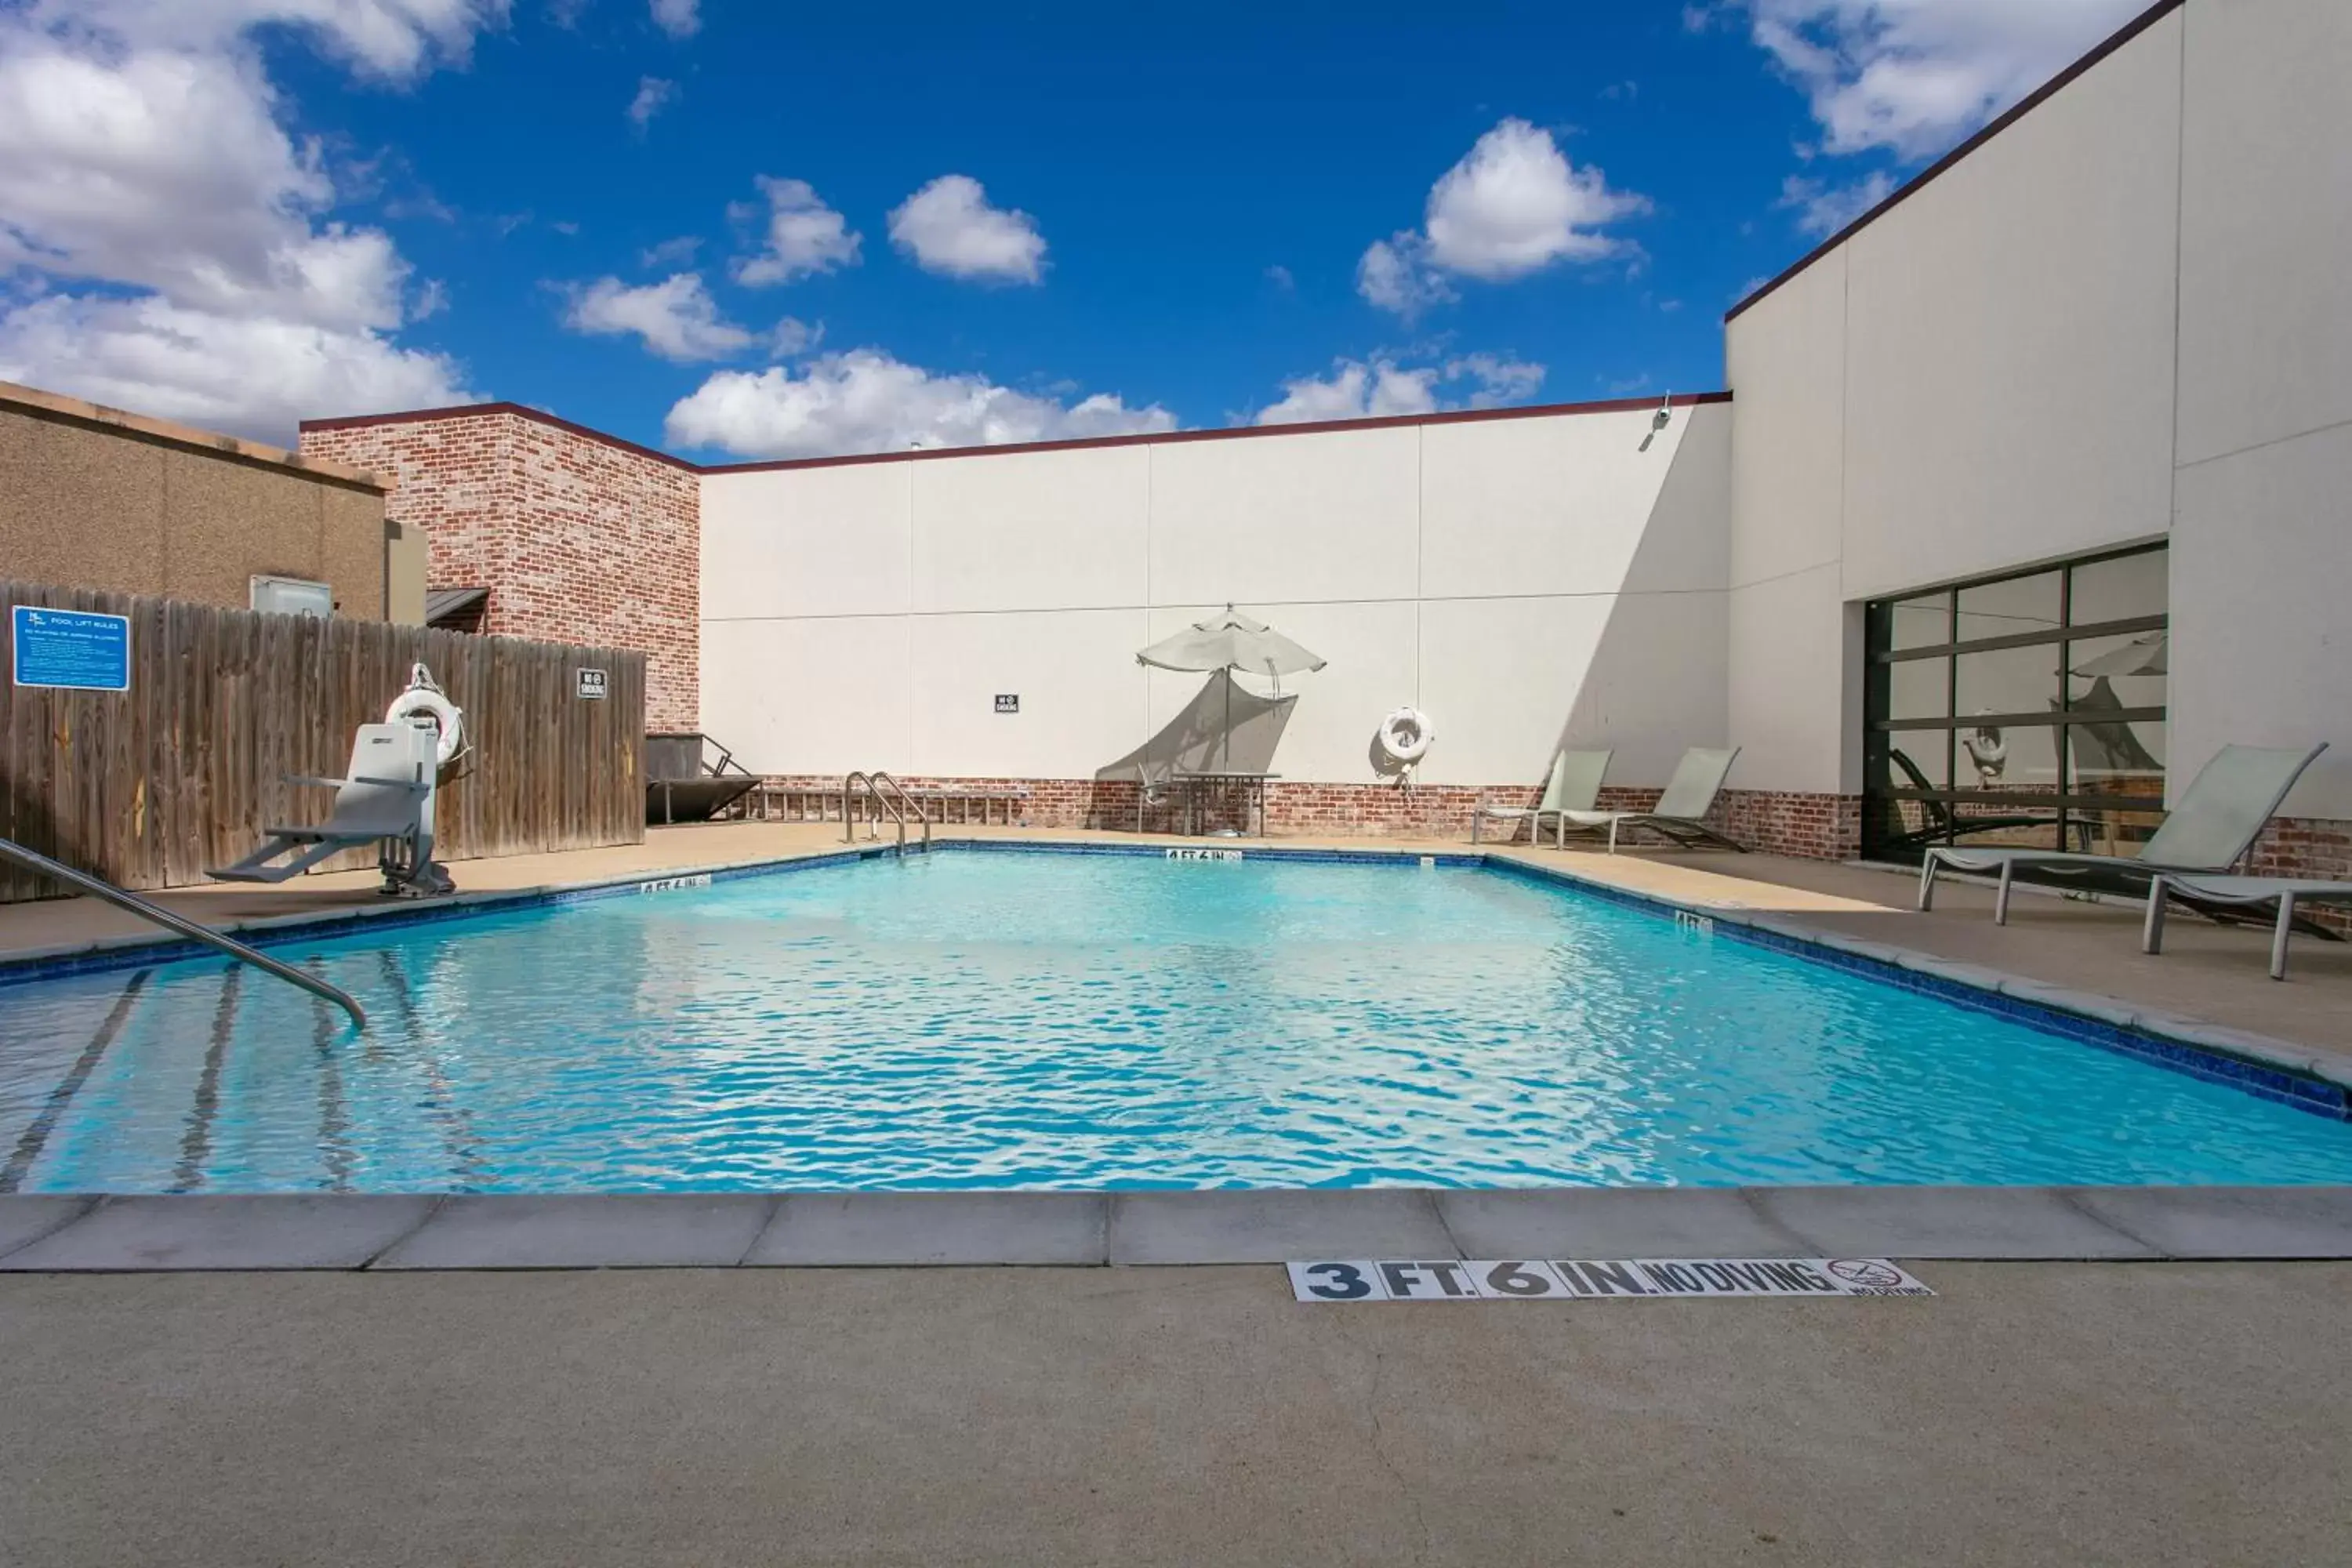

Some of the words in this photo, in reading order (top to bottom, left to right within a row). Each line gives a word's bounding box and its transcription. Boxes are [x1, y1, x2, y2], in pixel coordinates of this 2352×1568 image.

[51, 617, 73, 626] POOL
[1307, 1263, 1371, 1298] 3
[1379, 1262, 1475, 1296] FT.
[1486, 1262, 1551, 1295] 6
[1555, 1262, 1659, 1294] IN.
[1640, 1263, 1704, 1293] NO
[1690, 1262, 1838, 1291] DIVING
